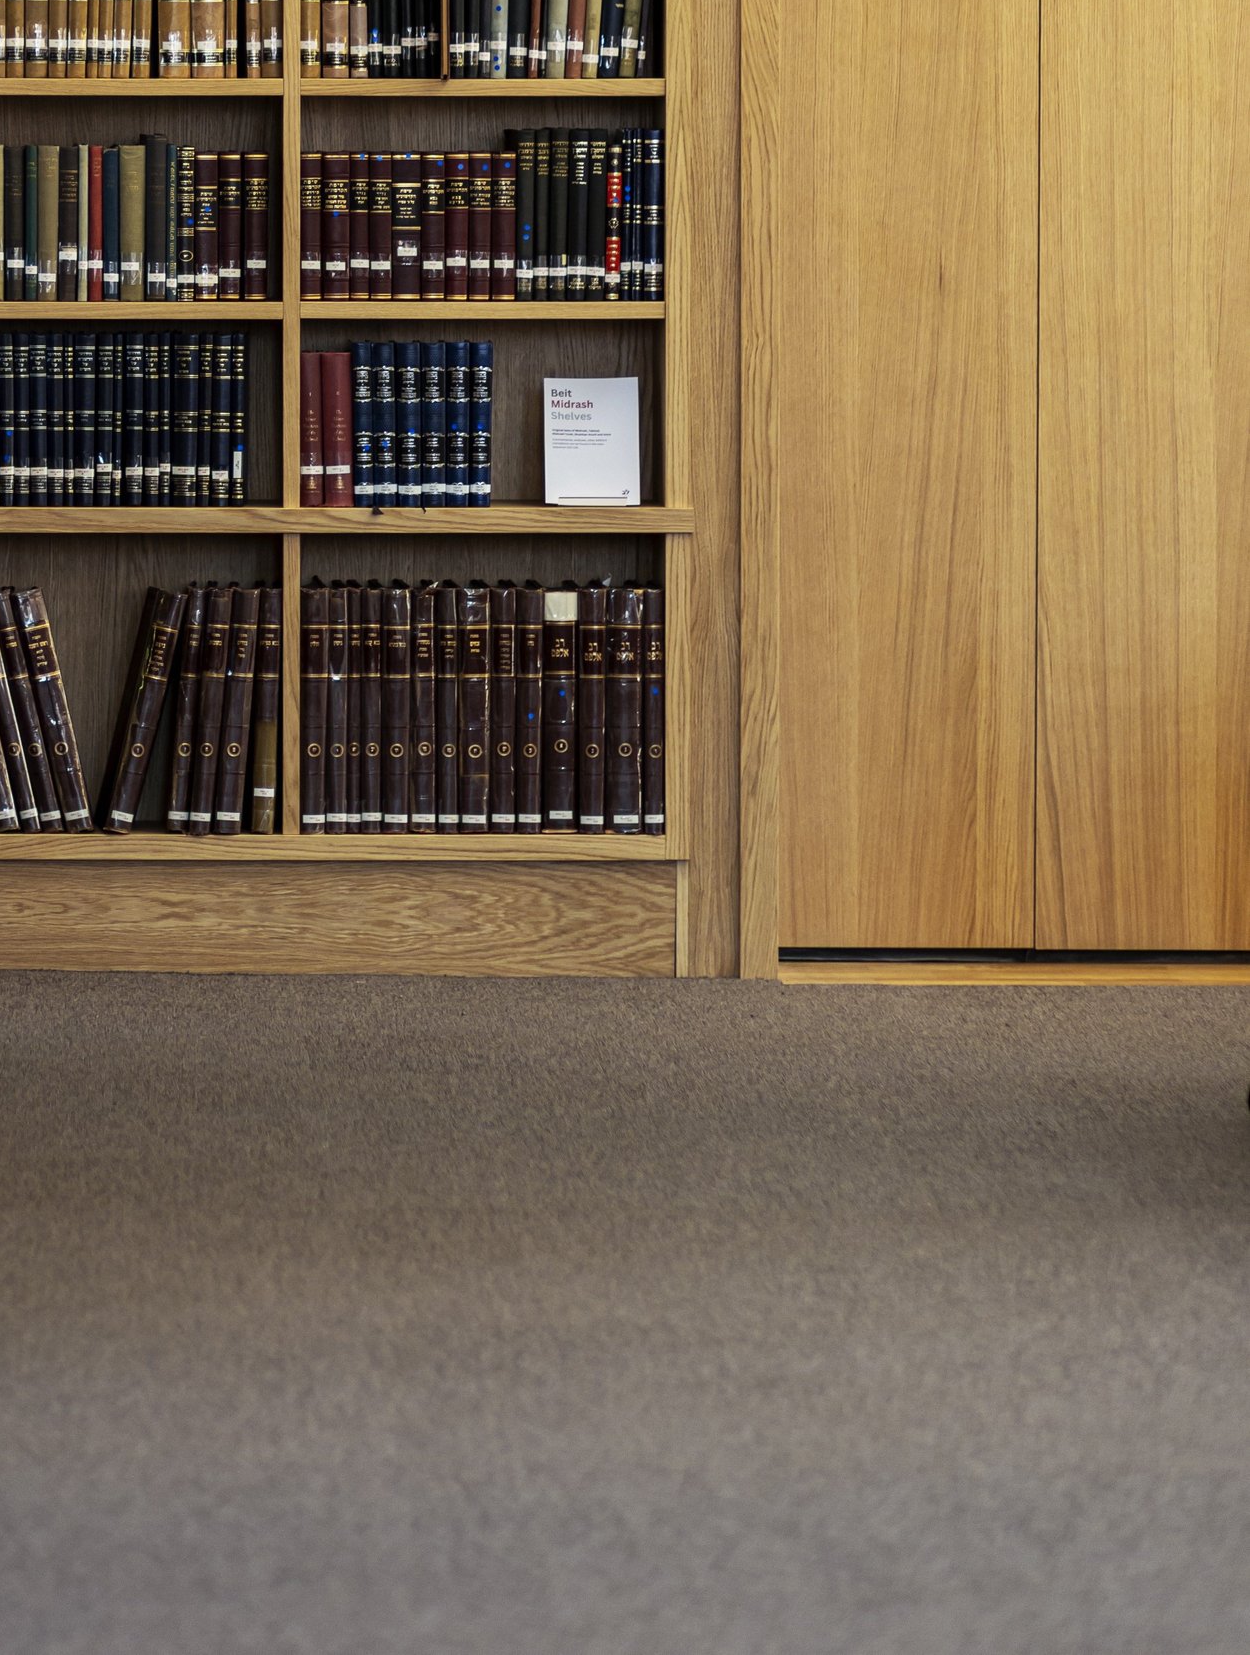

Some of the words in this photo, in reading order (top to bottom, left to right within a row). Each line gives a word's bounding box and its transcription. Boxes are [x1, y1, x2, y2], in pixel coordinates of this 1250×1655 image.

[551, 389, 572, 397] Beit
[551, 400, 593, 408] Midrash
[551, 412, 592, 420] Shelves
[556, 638, 565, 647] רב
[589, 642, 598, 651] רב
[620, 642, 630, 650] רב
[551, 648, 569, 658] אלפס
